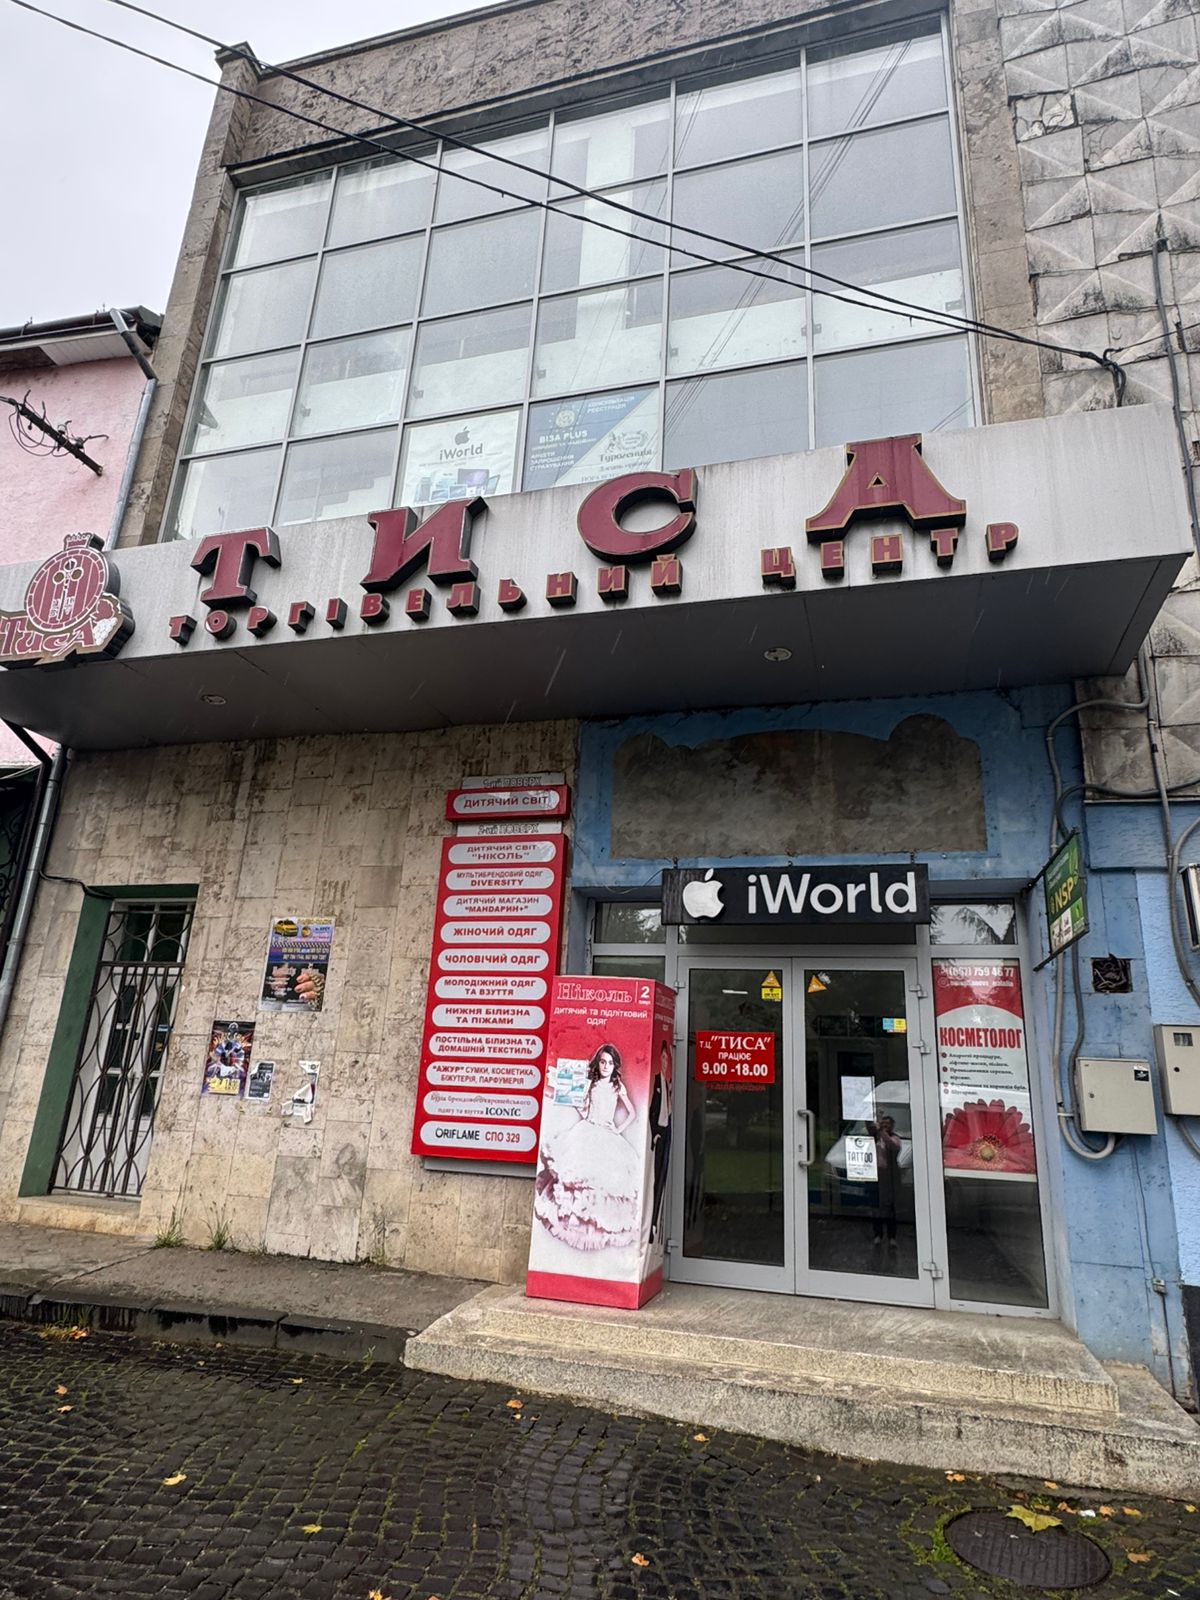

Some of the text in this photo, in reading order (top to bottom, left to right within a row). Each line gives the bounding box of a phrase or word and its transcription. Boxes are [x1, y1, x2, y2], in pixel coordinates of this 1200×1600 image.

[563, 430, 588, 440] PLUS
[440, 443, 483, 460] iWorld
[169, 521, 1018, 647] ТОРГІВЕЛЬНИЙ ЦЕНТР
[463, 796, 548, 809] ДИТЯЧИЙ СВІТ
[467, 844, 512, 853] ДИТЯЧИЙ
[472, 852, 530, 860] "НІКОЛЬ"
[456, 870, 543, 879] МУЛЬТИБРЕНДОВИЙ ОДЯГ
[747, 871, 917, 914] iWorld
[456, 897, 496, 905] ДИТЯЧИЙ
[453, 926, 537, 937] ЖІНОЧИЙ ОДЯГ
[445, 953, 540, 965] ЧОЛОВІЧИЙ ОДЯГ
[444, 978, 536, 988] МОЛОДІЖНИЙ ОДЯГ
[479, 988, 514, 996] ВЗУТТЯ
[556, 982, 650, 1003] Ніколь 2
[485, 1008, 530, 1016] БІЛИЗНА
[553, 1006, 587, 1016] дитячий
[600, 1009, 648, 1018] підлітковий
[456, 1016, 514, 1025] ТА ПІЖАМИ
[586, 1017, 608, 1026] одяг
[435, 1036, 537, 1046] ПОСТІЛЬНА БІЛИЗНА ТА
[711, 1035, 771, 1050] "ТИСА"
[939, 1027, 1022, 1049] КОСМЕТОЛОГ
[438, 1044, 532, 1055] ДОМАШНІЙ ТЕКСТИЛЬ
[718, 1052, 751, 1061] ПРАЦЮЄ
[492, 1068, 536, 1077] КОСМЕТИКА,
[702, 1062, 727, 1075] 9.00
[435, 1128, 520, 1143] ORIFLAME СПО 329
[847, 1151, 873, 1163] TATTOO
